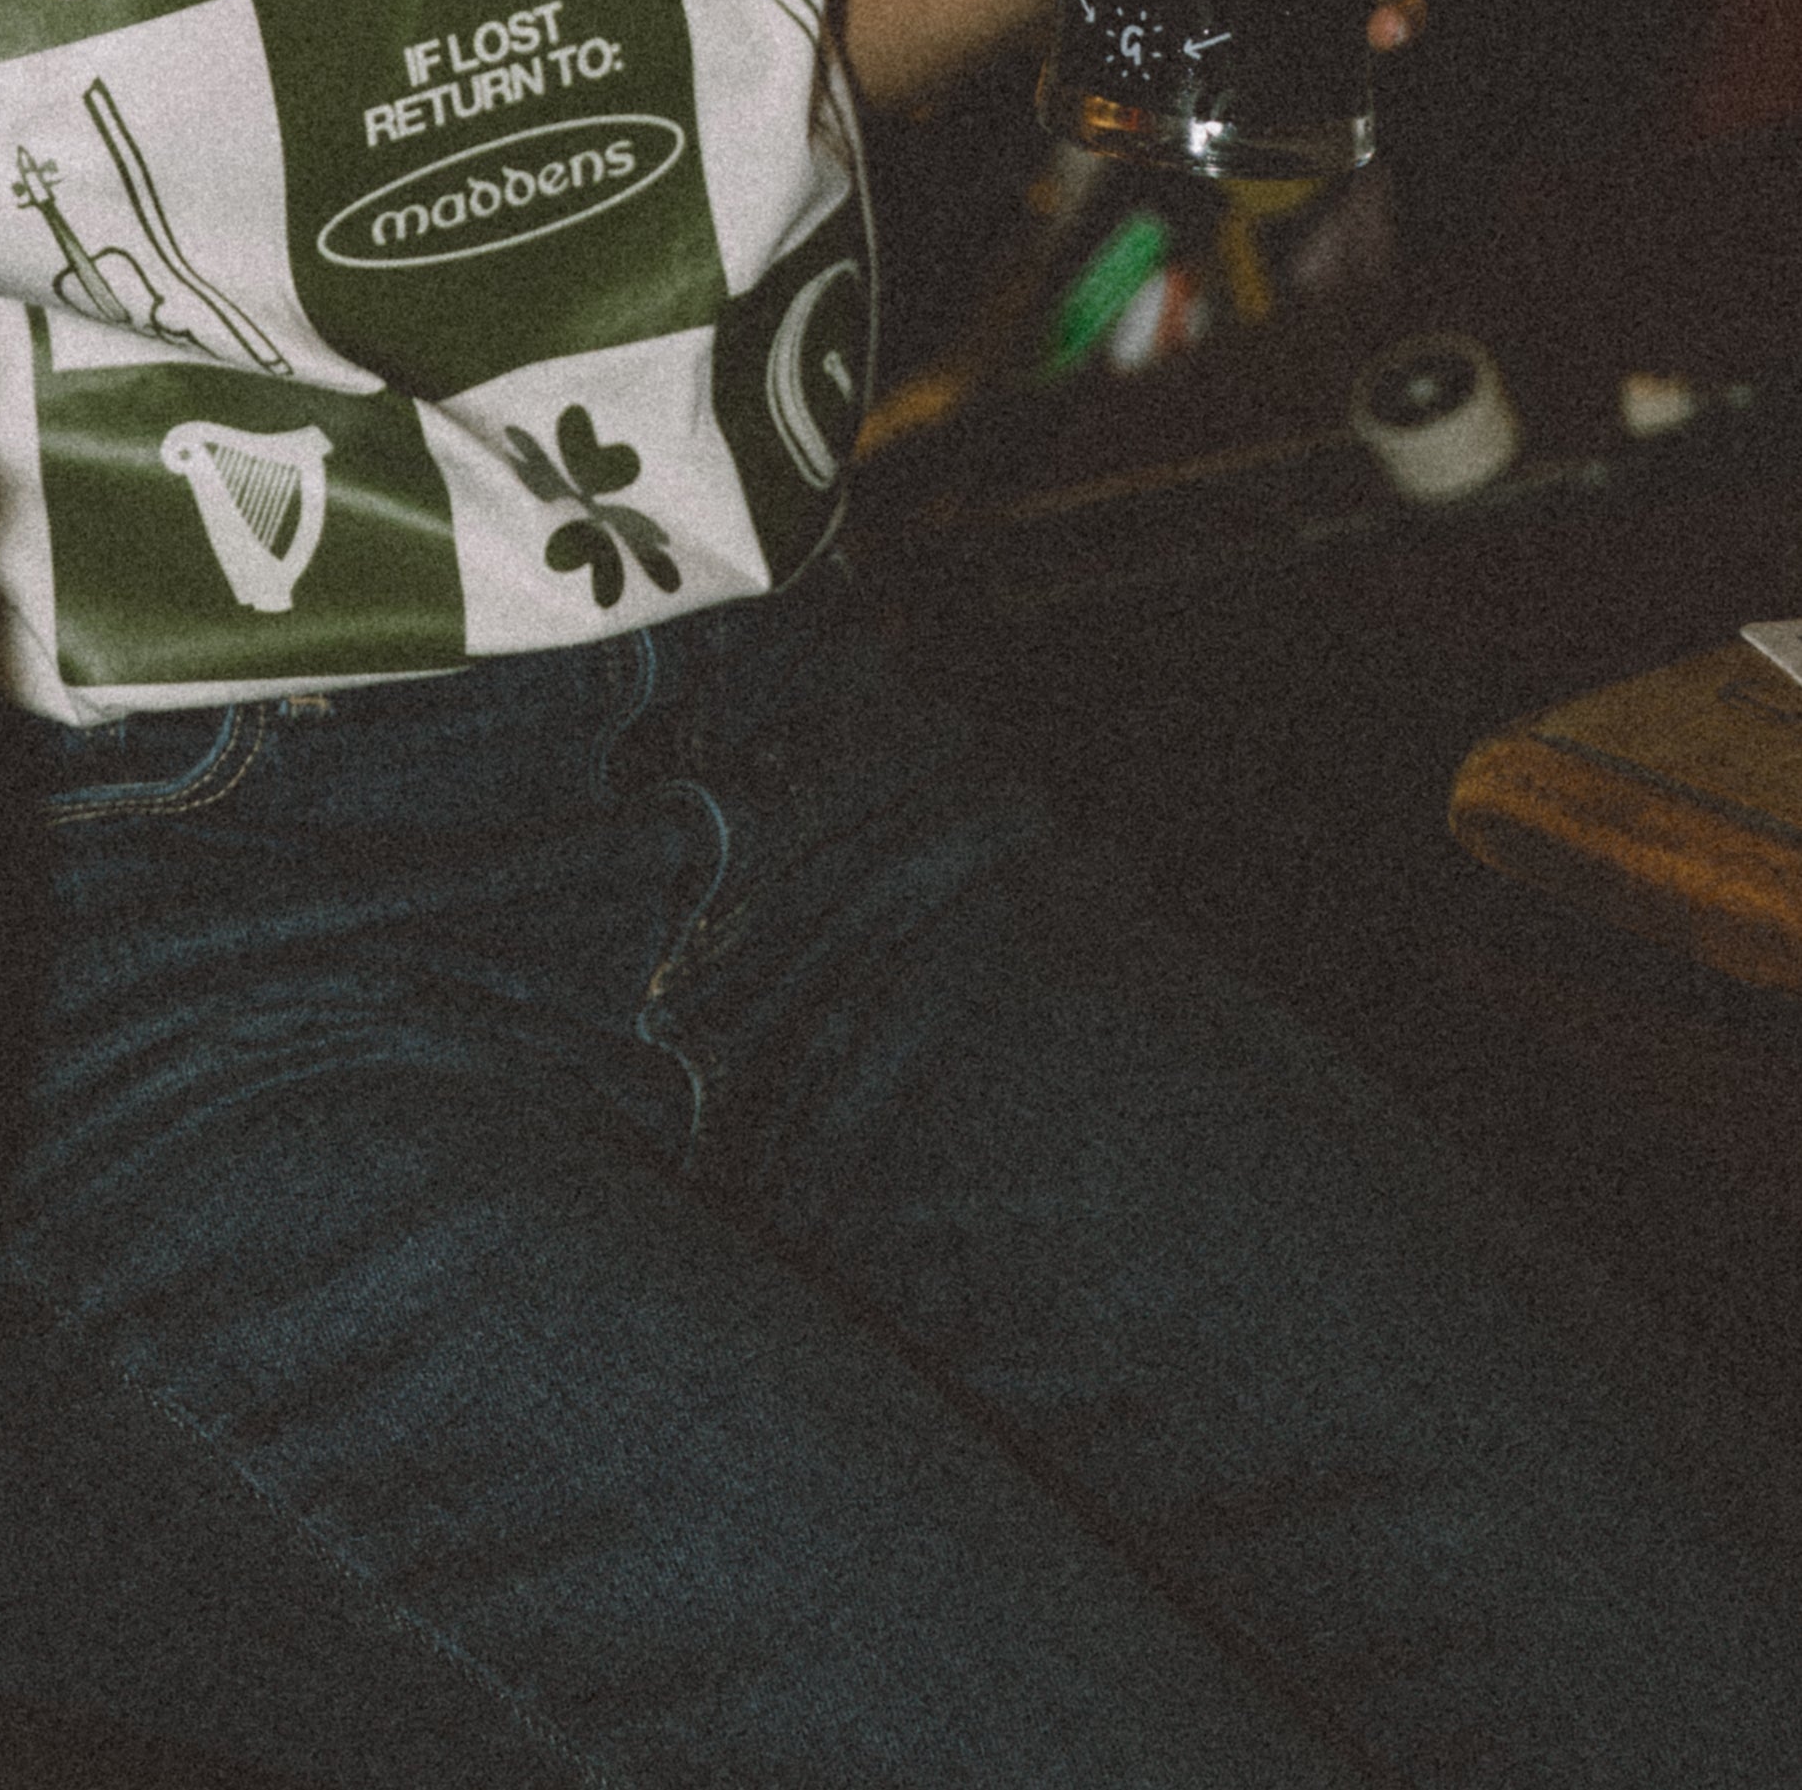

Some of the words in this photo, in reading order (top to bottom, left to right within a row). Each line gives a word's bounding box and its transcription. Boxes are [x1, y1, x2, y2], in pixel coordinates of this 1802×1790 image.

[403, 39, 441, 87] IF
[447, 0, 563, 73] LOST
[1120, 25, 1144, 66] G
[364, 57, 545, 148] RETURN
[548, 37, 625, 87] TO:
[371, 140, 636, 246] maddens
